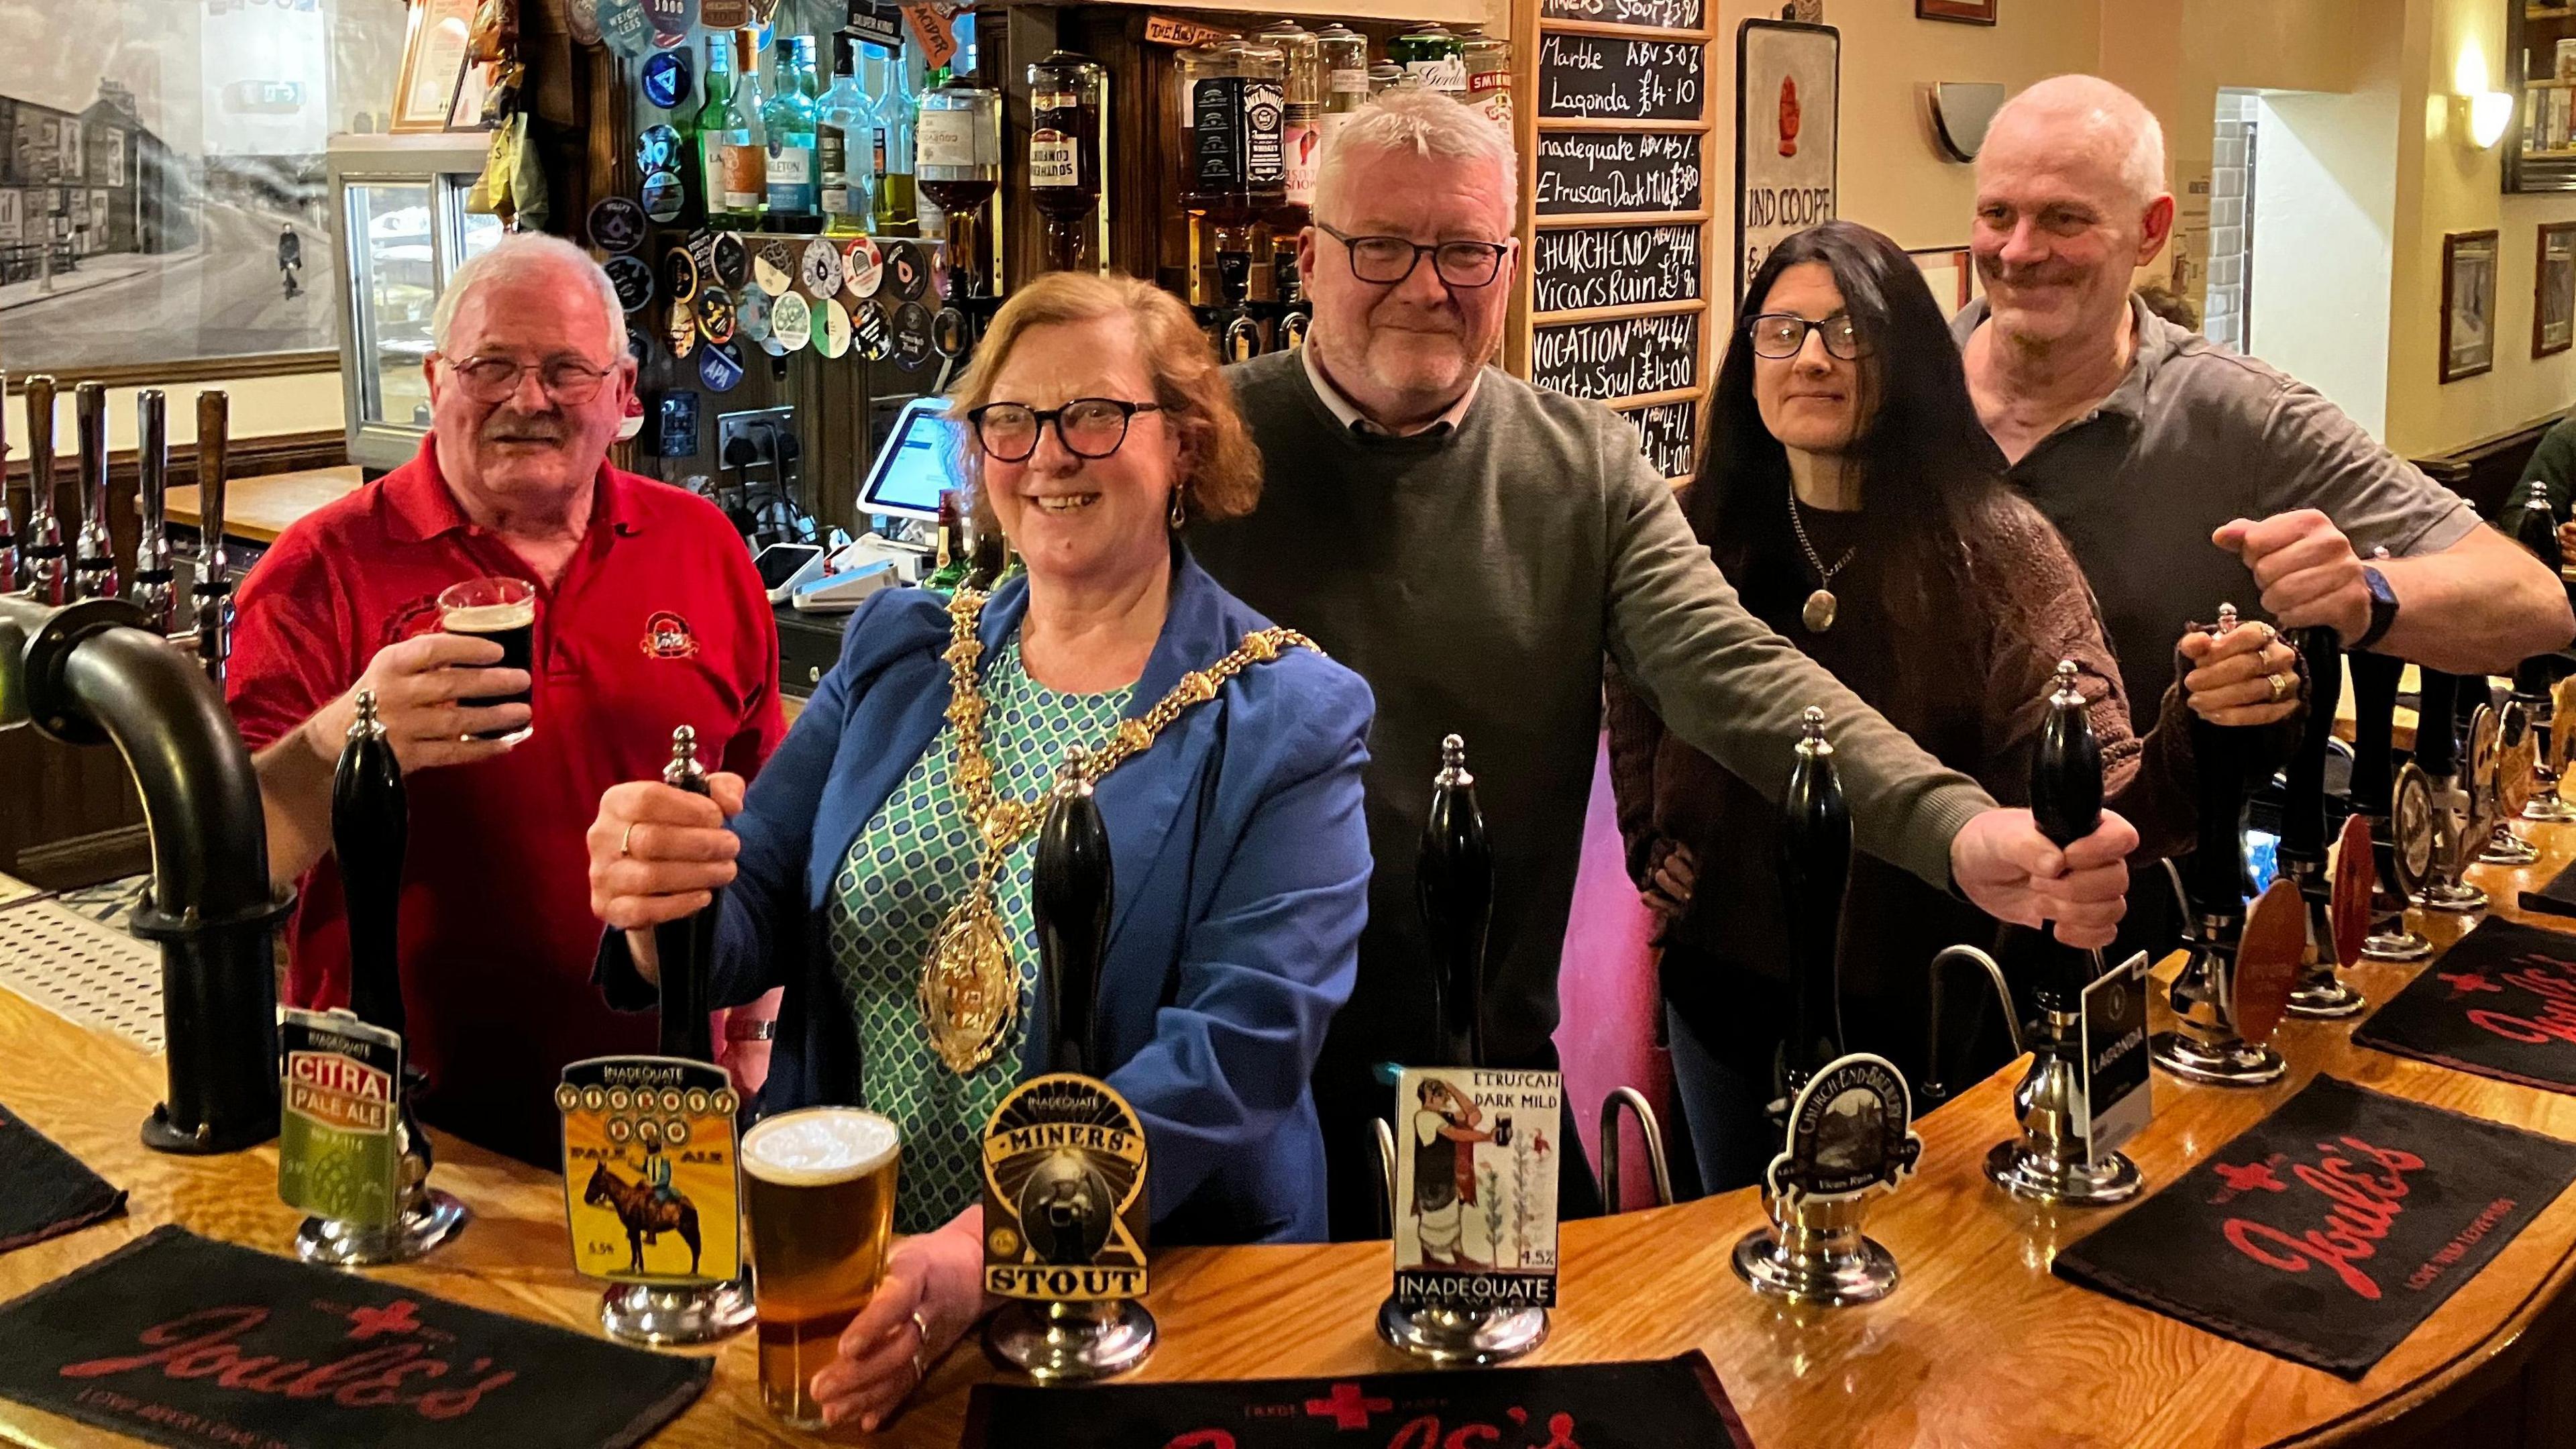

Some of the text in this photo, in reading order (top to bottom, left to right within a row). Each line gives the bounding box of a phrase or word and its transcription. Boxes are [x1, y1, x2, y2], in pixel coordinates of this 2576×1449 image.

[618, 18, 641, 35] LESS
[1540, 36, 1603, 70] Marble
[1625, 42, 1658, 66] ABV
[1550, 76, 1629, 118] Lagonda
[1538, 135, 1635, 172] Inadequate
[1536, 172, 1612, 206] Etruscan
[1608, 170, 1644, 207] Dark
[1748, 189, 1776, 226] IND
[1534, 321, 1631, 372] VOCATION
[1631, 319, 1659, 338] ABV
[705, 360, 730, 388] APA
[1594, 356, 1634, 398] Soul
[296, 1057, 380, 1101] CITRA
[604, 1065, 684, 1081] INADEQUATE
[1474, 1073, 1559, 1089] ETRUSCAN
[296, 1090, 381, 1128] PALE ALE
[1028, 1097, 1097, 1108] INADEQUATE
[1474, 1093, 1557, 1109] DARK MILD
[1009, 1126, 1124, 1151] MINERS
[991, 1268, 1140, 1295] STOUT
[1401, 1276, 1549, 1299] INADEQUATE
